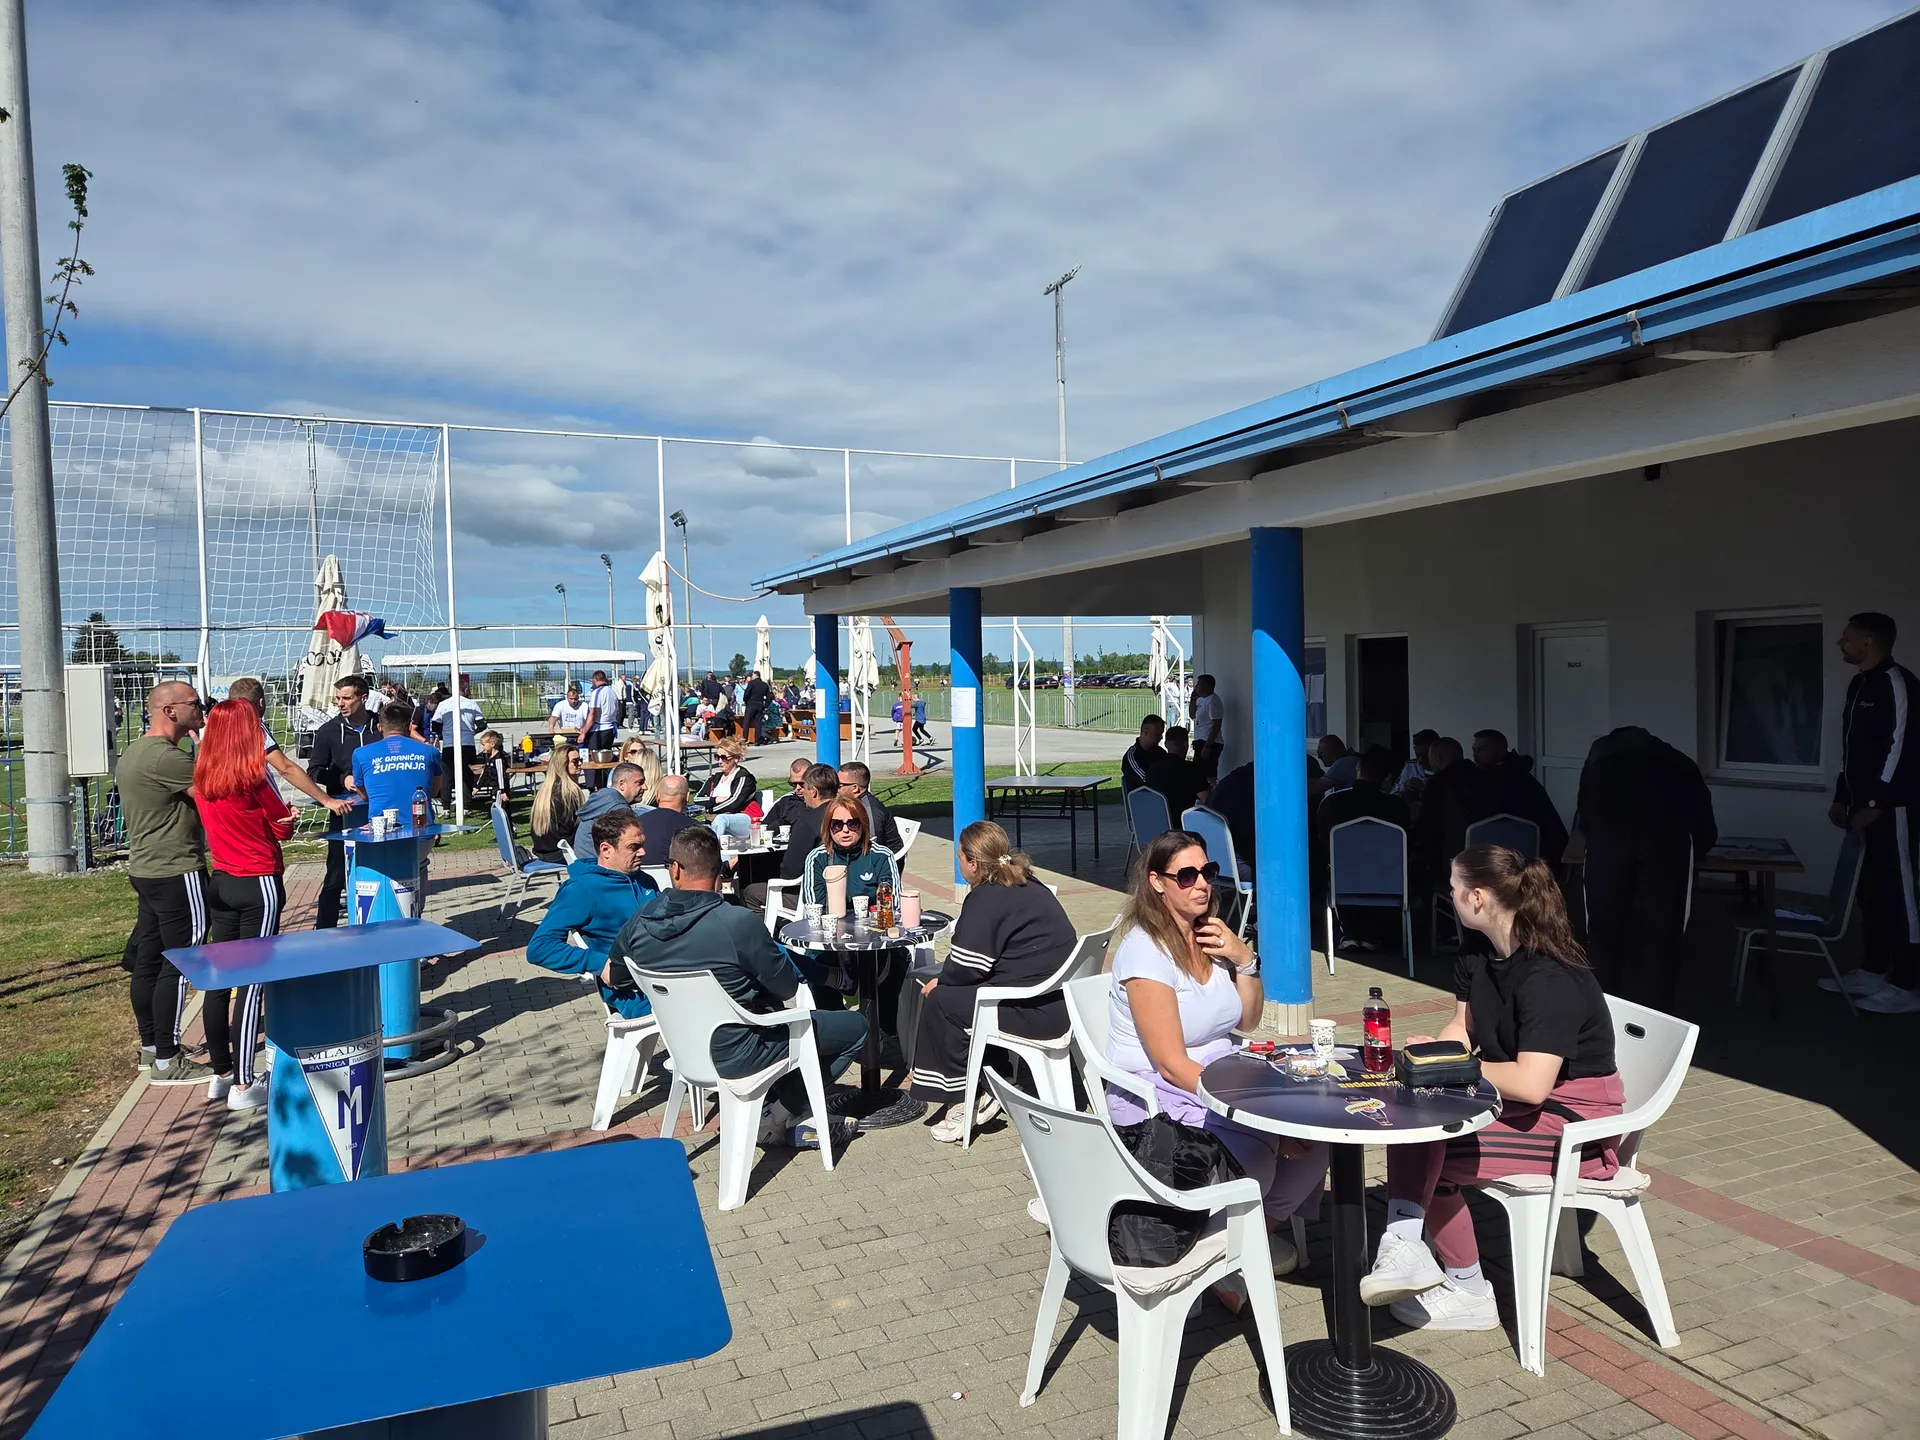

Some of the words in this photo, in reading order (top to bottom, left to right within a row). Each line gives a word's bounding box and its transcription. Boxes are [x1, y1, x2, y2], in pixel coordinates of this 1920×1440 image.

[373, 762, 426, 775] ŽUPANJA
[308, 1038, 378, 1060] MLADOST
[309, 1060, 346, 1071] SATNICA
[337, 1085, 363, 1130] M
